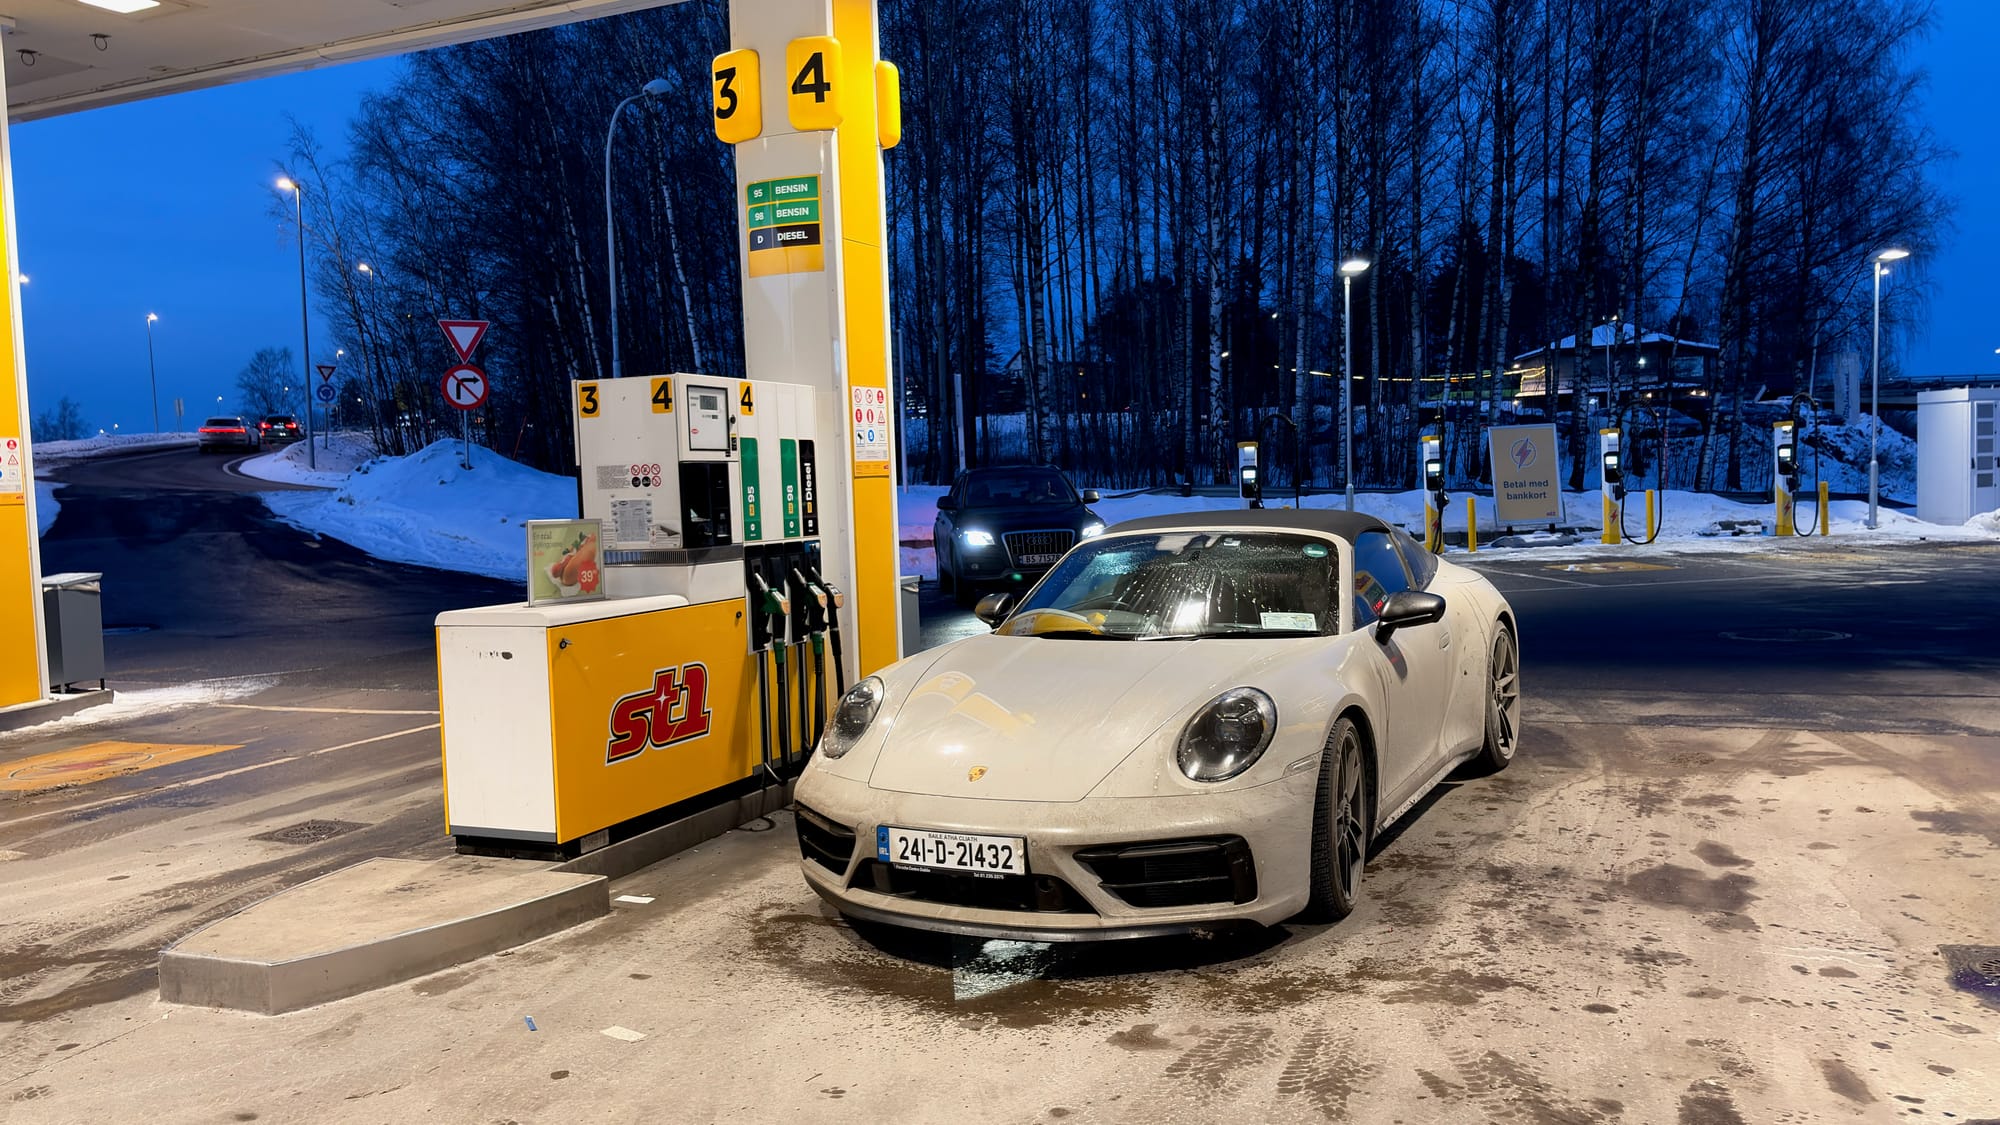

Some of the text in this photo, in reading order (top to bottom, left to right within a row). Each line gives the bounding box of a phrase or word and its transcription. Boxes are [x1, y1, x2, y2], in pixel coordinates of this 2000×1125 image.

[792, 52, 830, 103] 4
[715, 67, 737, 120] 3
[753, 184, 808, 198] 95 BENSIN
[754, 207, 809, 221] 98 BENSIN
[757, 231, 808, 244] D DIESEL
[581, 386, 598, 414] 3
[652, 381, 672, 409] 4
[741, 386, 753, 412] 4
[804, 462, 813, 501] Diesel
[1503, 480, 1526, 488] Betal
[747, 486, 755, 503] 95
[786, 485, 794, 501] 98
[1507, 491, 1547, 500] bankkort
[581, 570, 593, 582] 39
[605, 661, 712, 766] st1
[899, 836, 1013, 870] 241-D-21432
